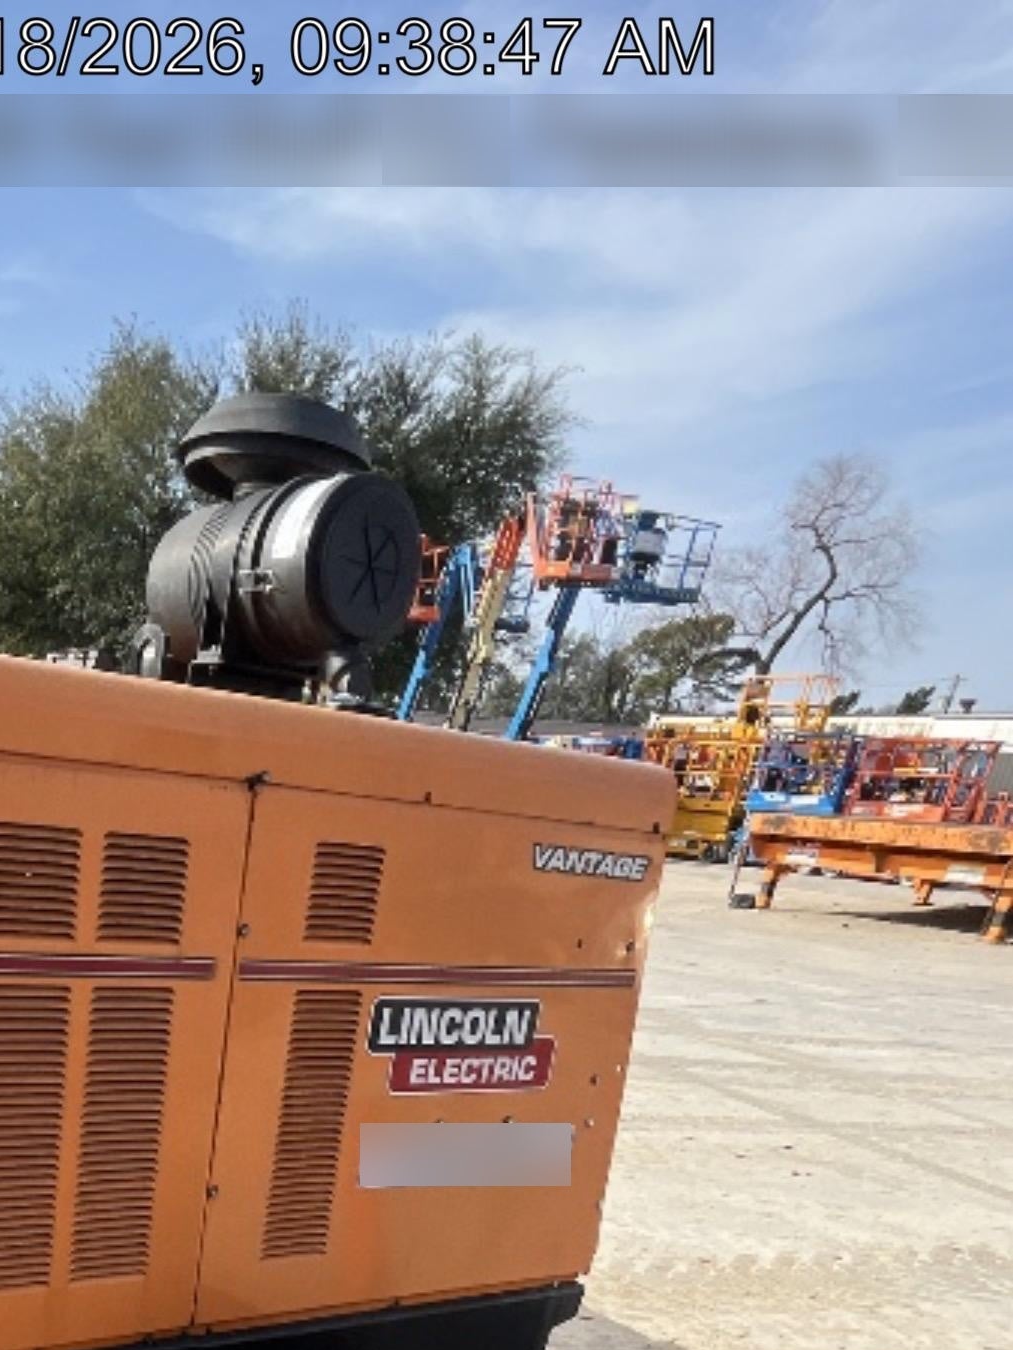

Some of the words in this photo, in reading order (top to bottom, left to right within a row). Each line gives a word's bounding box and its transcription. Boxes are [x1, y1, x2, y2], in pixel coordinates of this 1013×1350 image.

[533, 844, 650, 882] VANTAGE
[377, 1005, 531, 1047] LINCOLN
[409, 1055, 538, 1085] ELECTRIC
